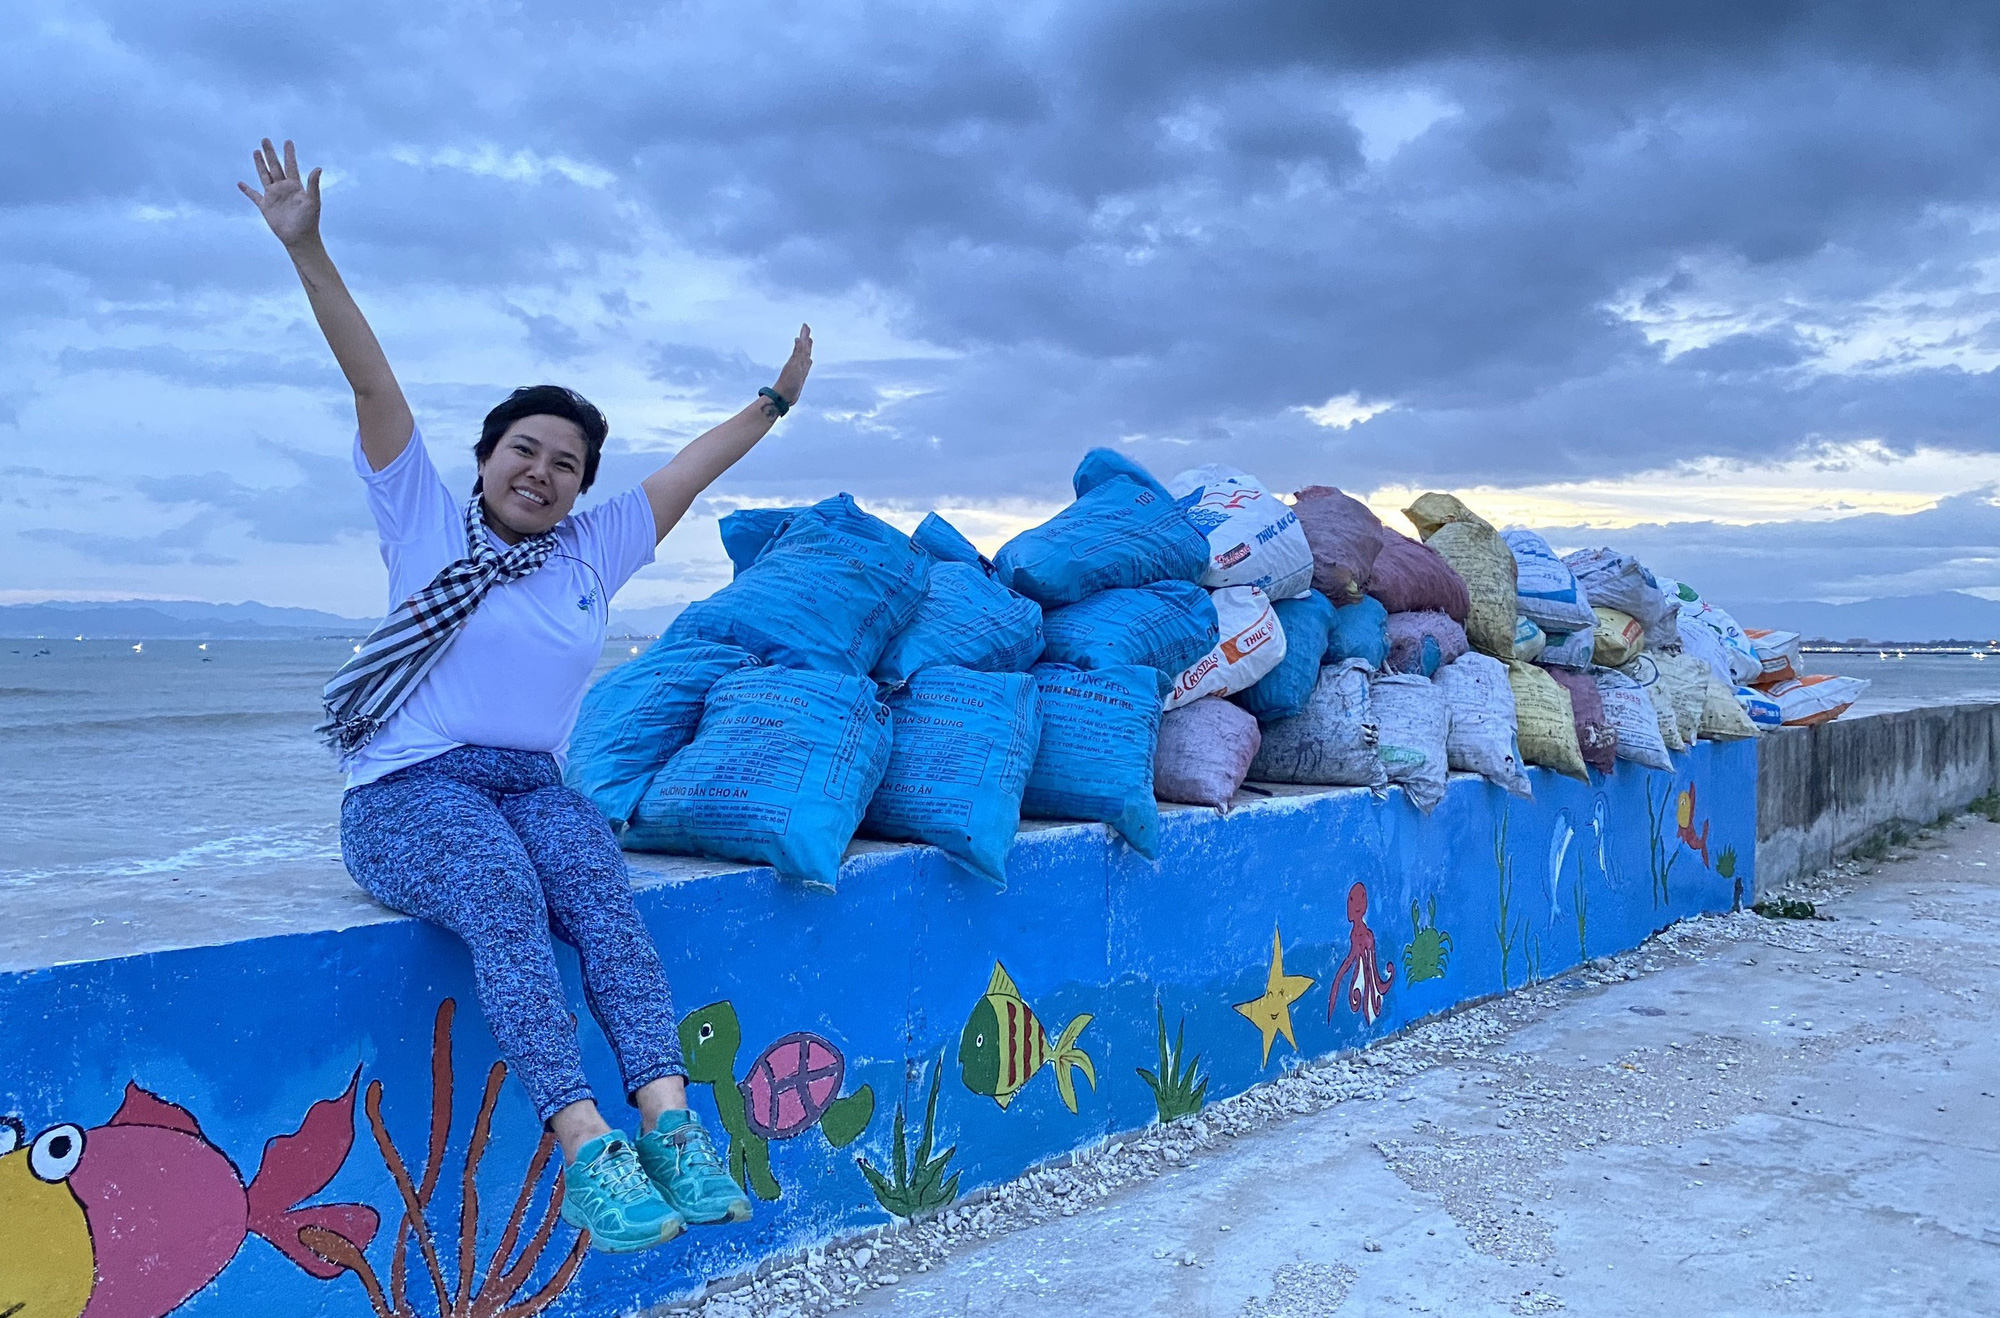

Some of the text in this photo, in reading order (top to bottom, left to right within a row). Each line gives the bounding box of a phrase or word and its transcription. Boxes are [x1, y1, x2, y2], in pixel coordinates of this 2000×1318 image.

[1134, 491, 1156, 507] 103
[737, 690, 780, 701] NGUYÊN
[916, 692, 959, 703] NGUYÊN
[708, 786, 730, 798] CHO
[894, 783, 916, 794] CHO
